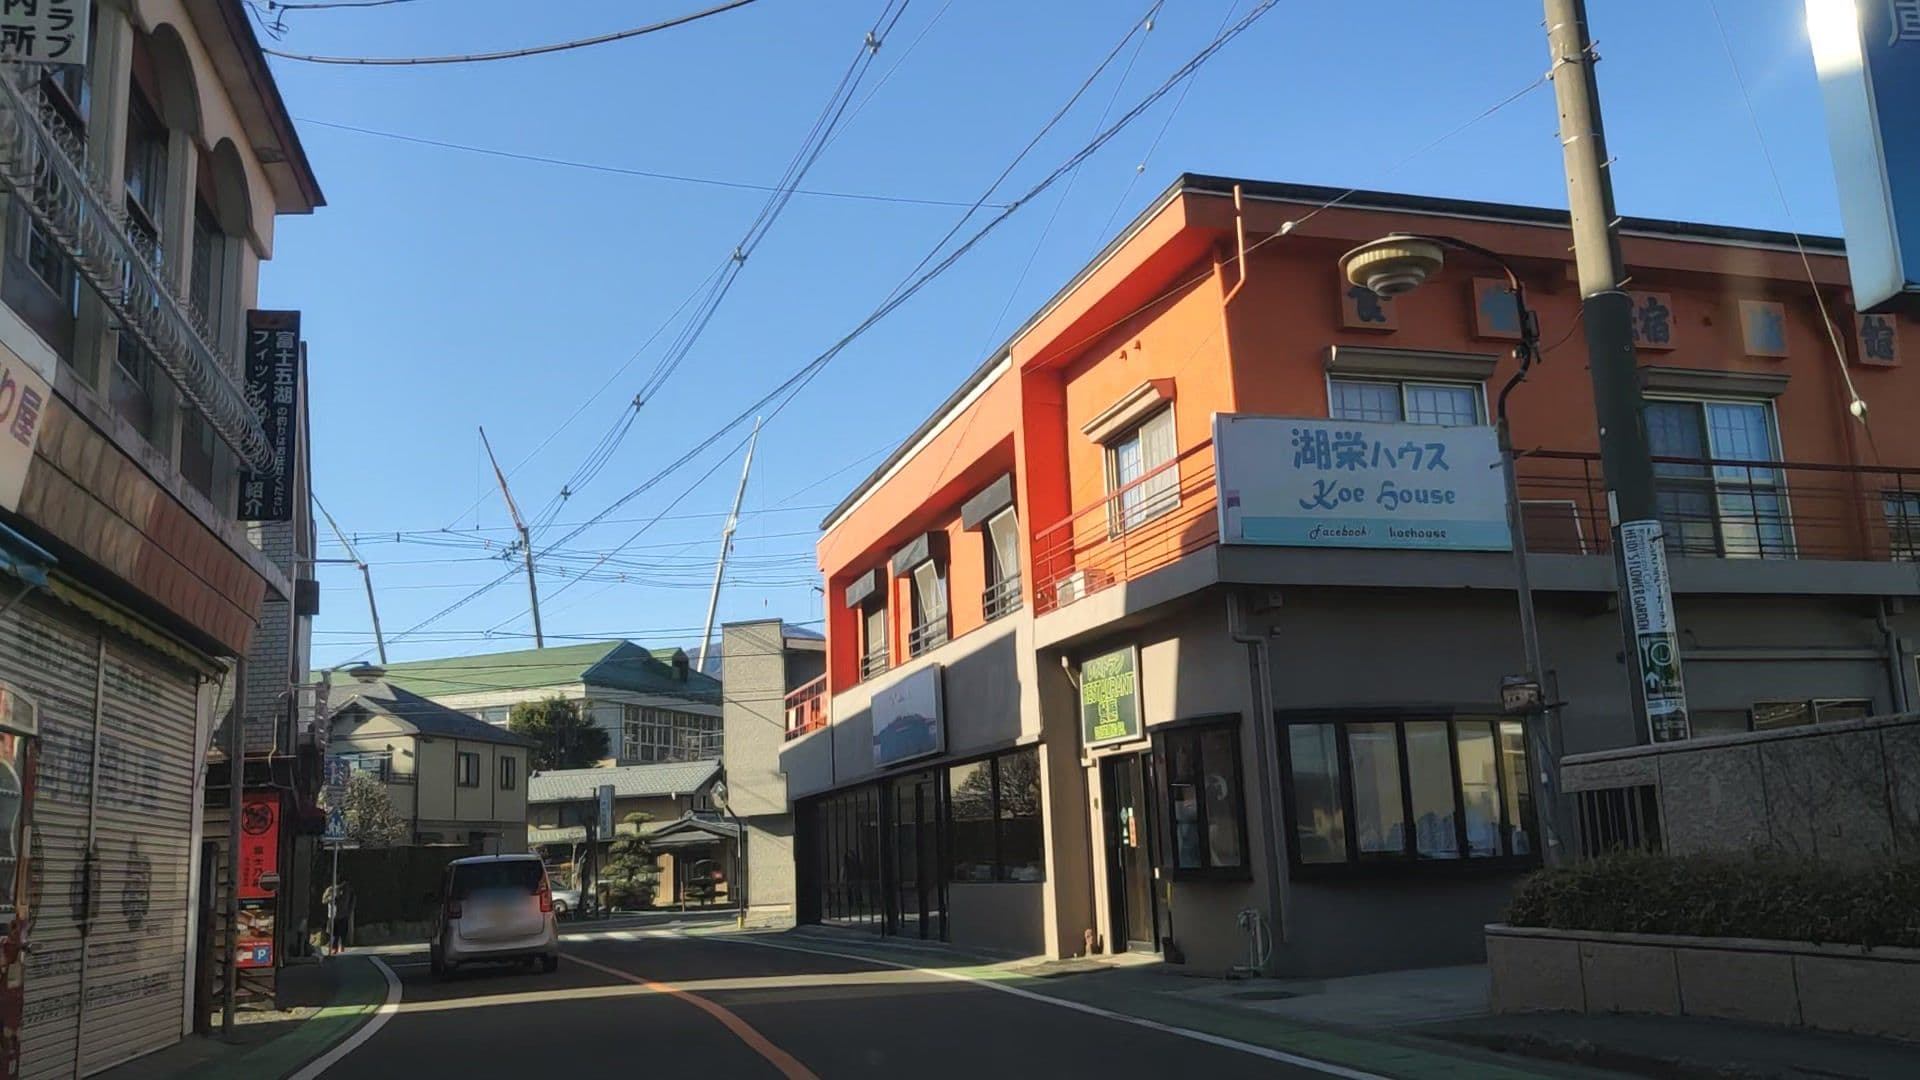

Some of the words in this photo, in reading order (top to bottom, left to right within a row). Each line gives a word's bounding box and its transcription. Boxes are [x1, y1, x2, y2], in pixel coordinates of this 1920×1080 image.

[46, 0, 76, 58] ラブ
[1291, 428, 1450, 471] 湖栄ハウス
[1299, 479, 1364, 510] Koe
[1081, 671, 1134, 705] RESTAURANT
